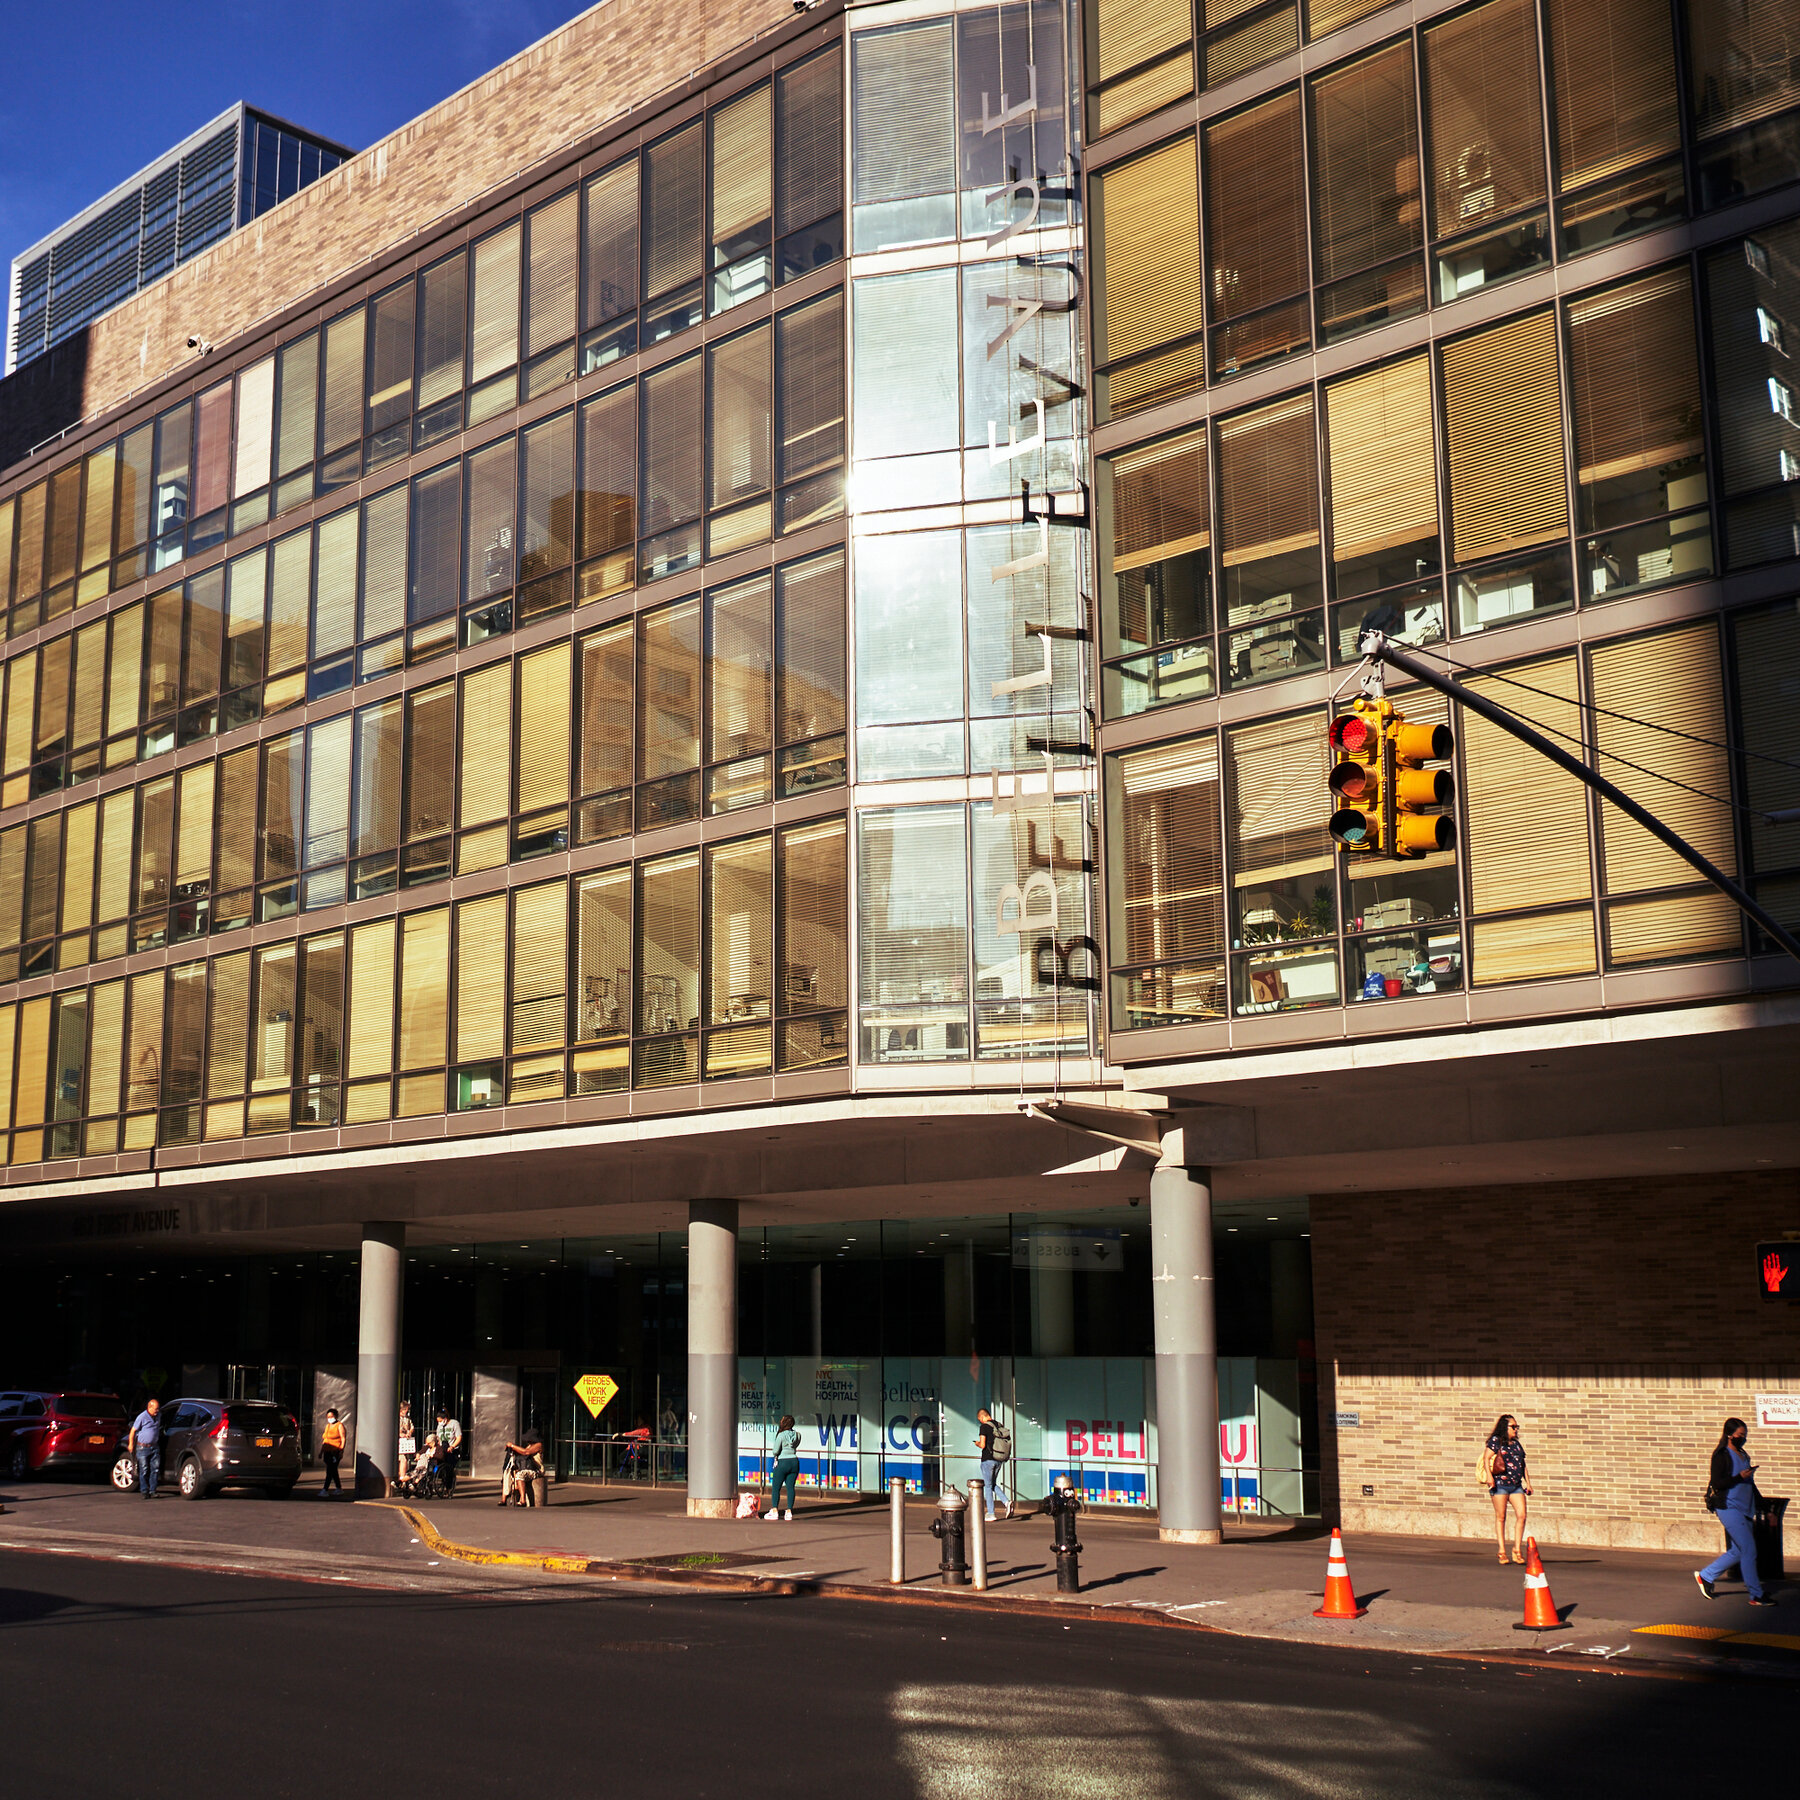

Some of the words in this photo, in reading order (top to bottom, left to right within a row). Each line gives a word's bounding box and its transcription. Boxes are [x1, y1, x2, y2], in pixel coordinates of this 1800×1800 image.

[981, 64, 1059, 936] BELLEVUE
[97, 1212, 130, 1236] FIRST
[132, 1208, 180, 1233] AVENUE
[816, 1370, 832, 1380] NYC
[583, 1376, 611, 1386] HEROES
[586, 1386, 607, 1396] WORK
[741, 1382, 757, 1391] NYC
[587, 1396, 606, 1405] HERE
[741, 1400, 781, 1410] HOSPIALS
[1758, 1397, 1800, 1406] EMERGENC
[1770, 1407, 1792, 1415] WALK
